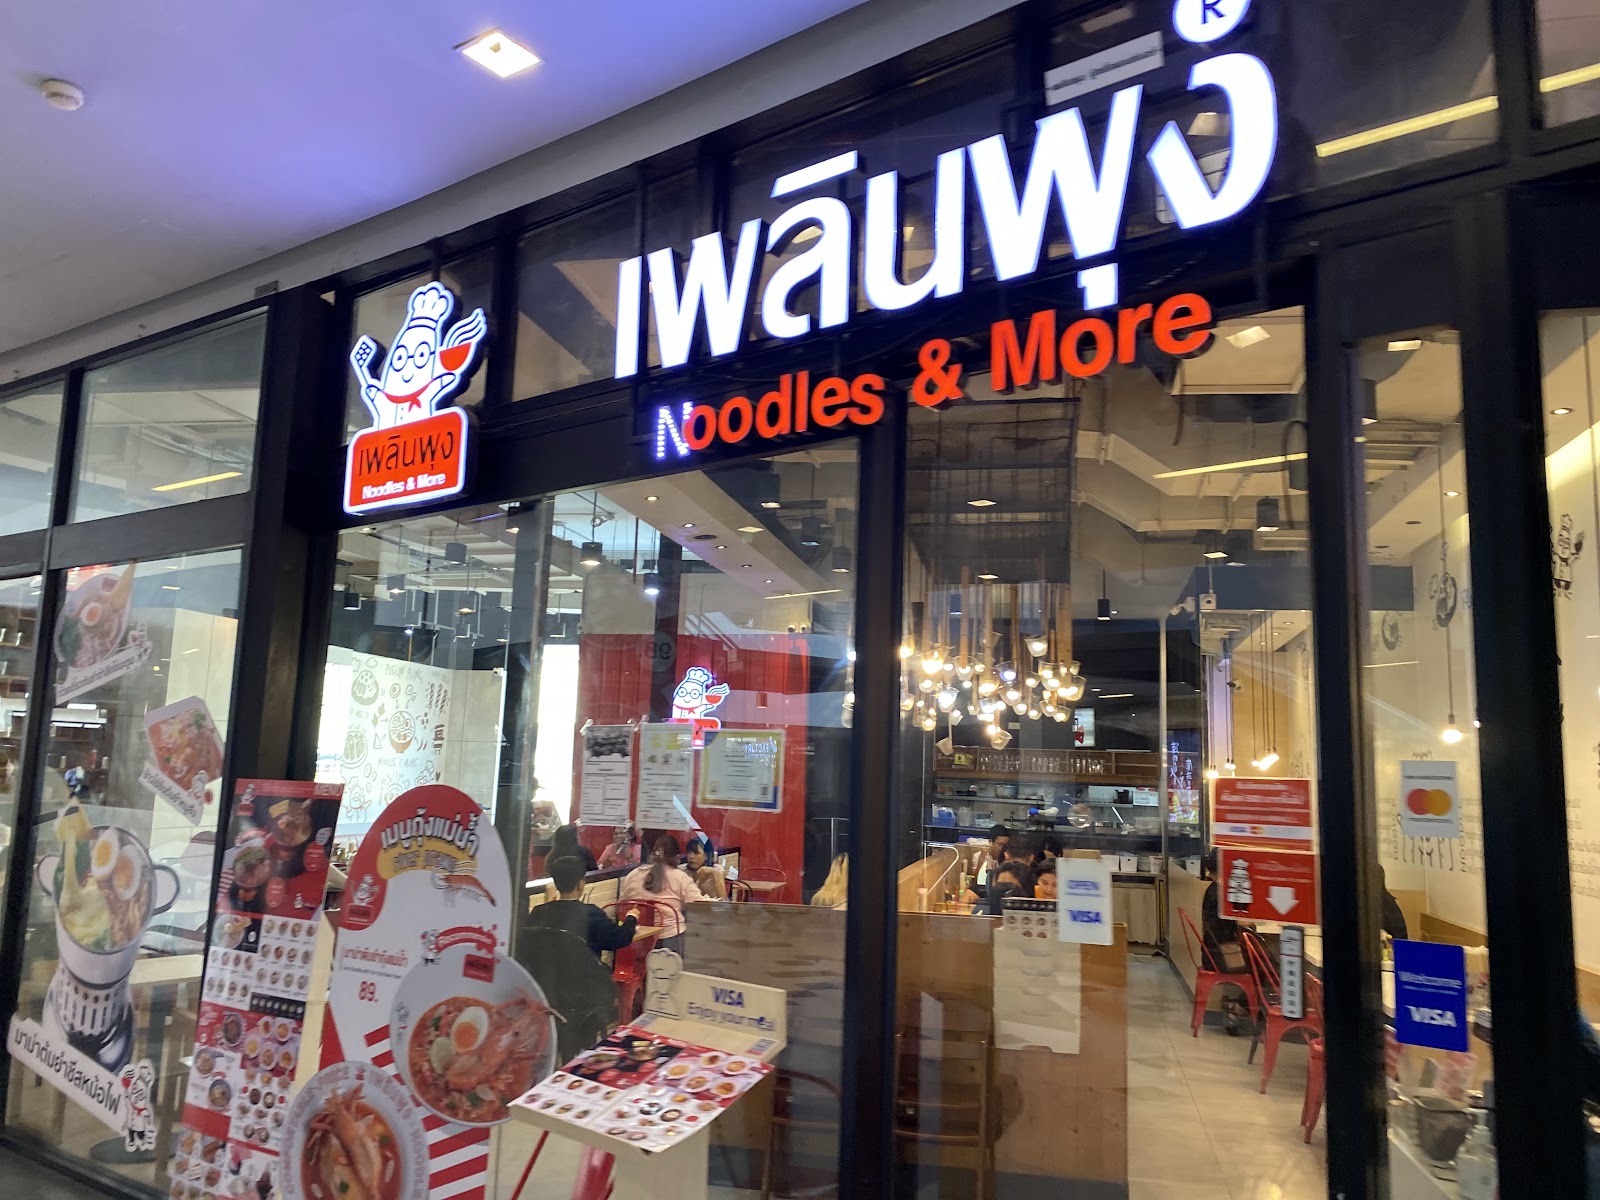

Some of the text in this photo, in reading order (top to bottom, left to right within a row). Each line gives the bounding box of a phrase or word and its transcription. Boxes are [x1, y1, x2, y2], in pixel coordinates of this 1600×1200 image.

[613, 52, 1280, 380] เพลินพุง
[655, 293, 1212, 460] Noodles & More
[359, 431, 454, 476] เพลินพุง
[362, 473, 446, 499] Noodles & More
[709, 986, 745, 1008] VISA
[687, 1001, 717, 1021] Enjoy
[1405, 1005, 1457, 1027] VISA
